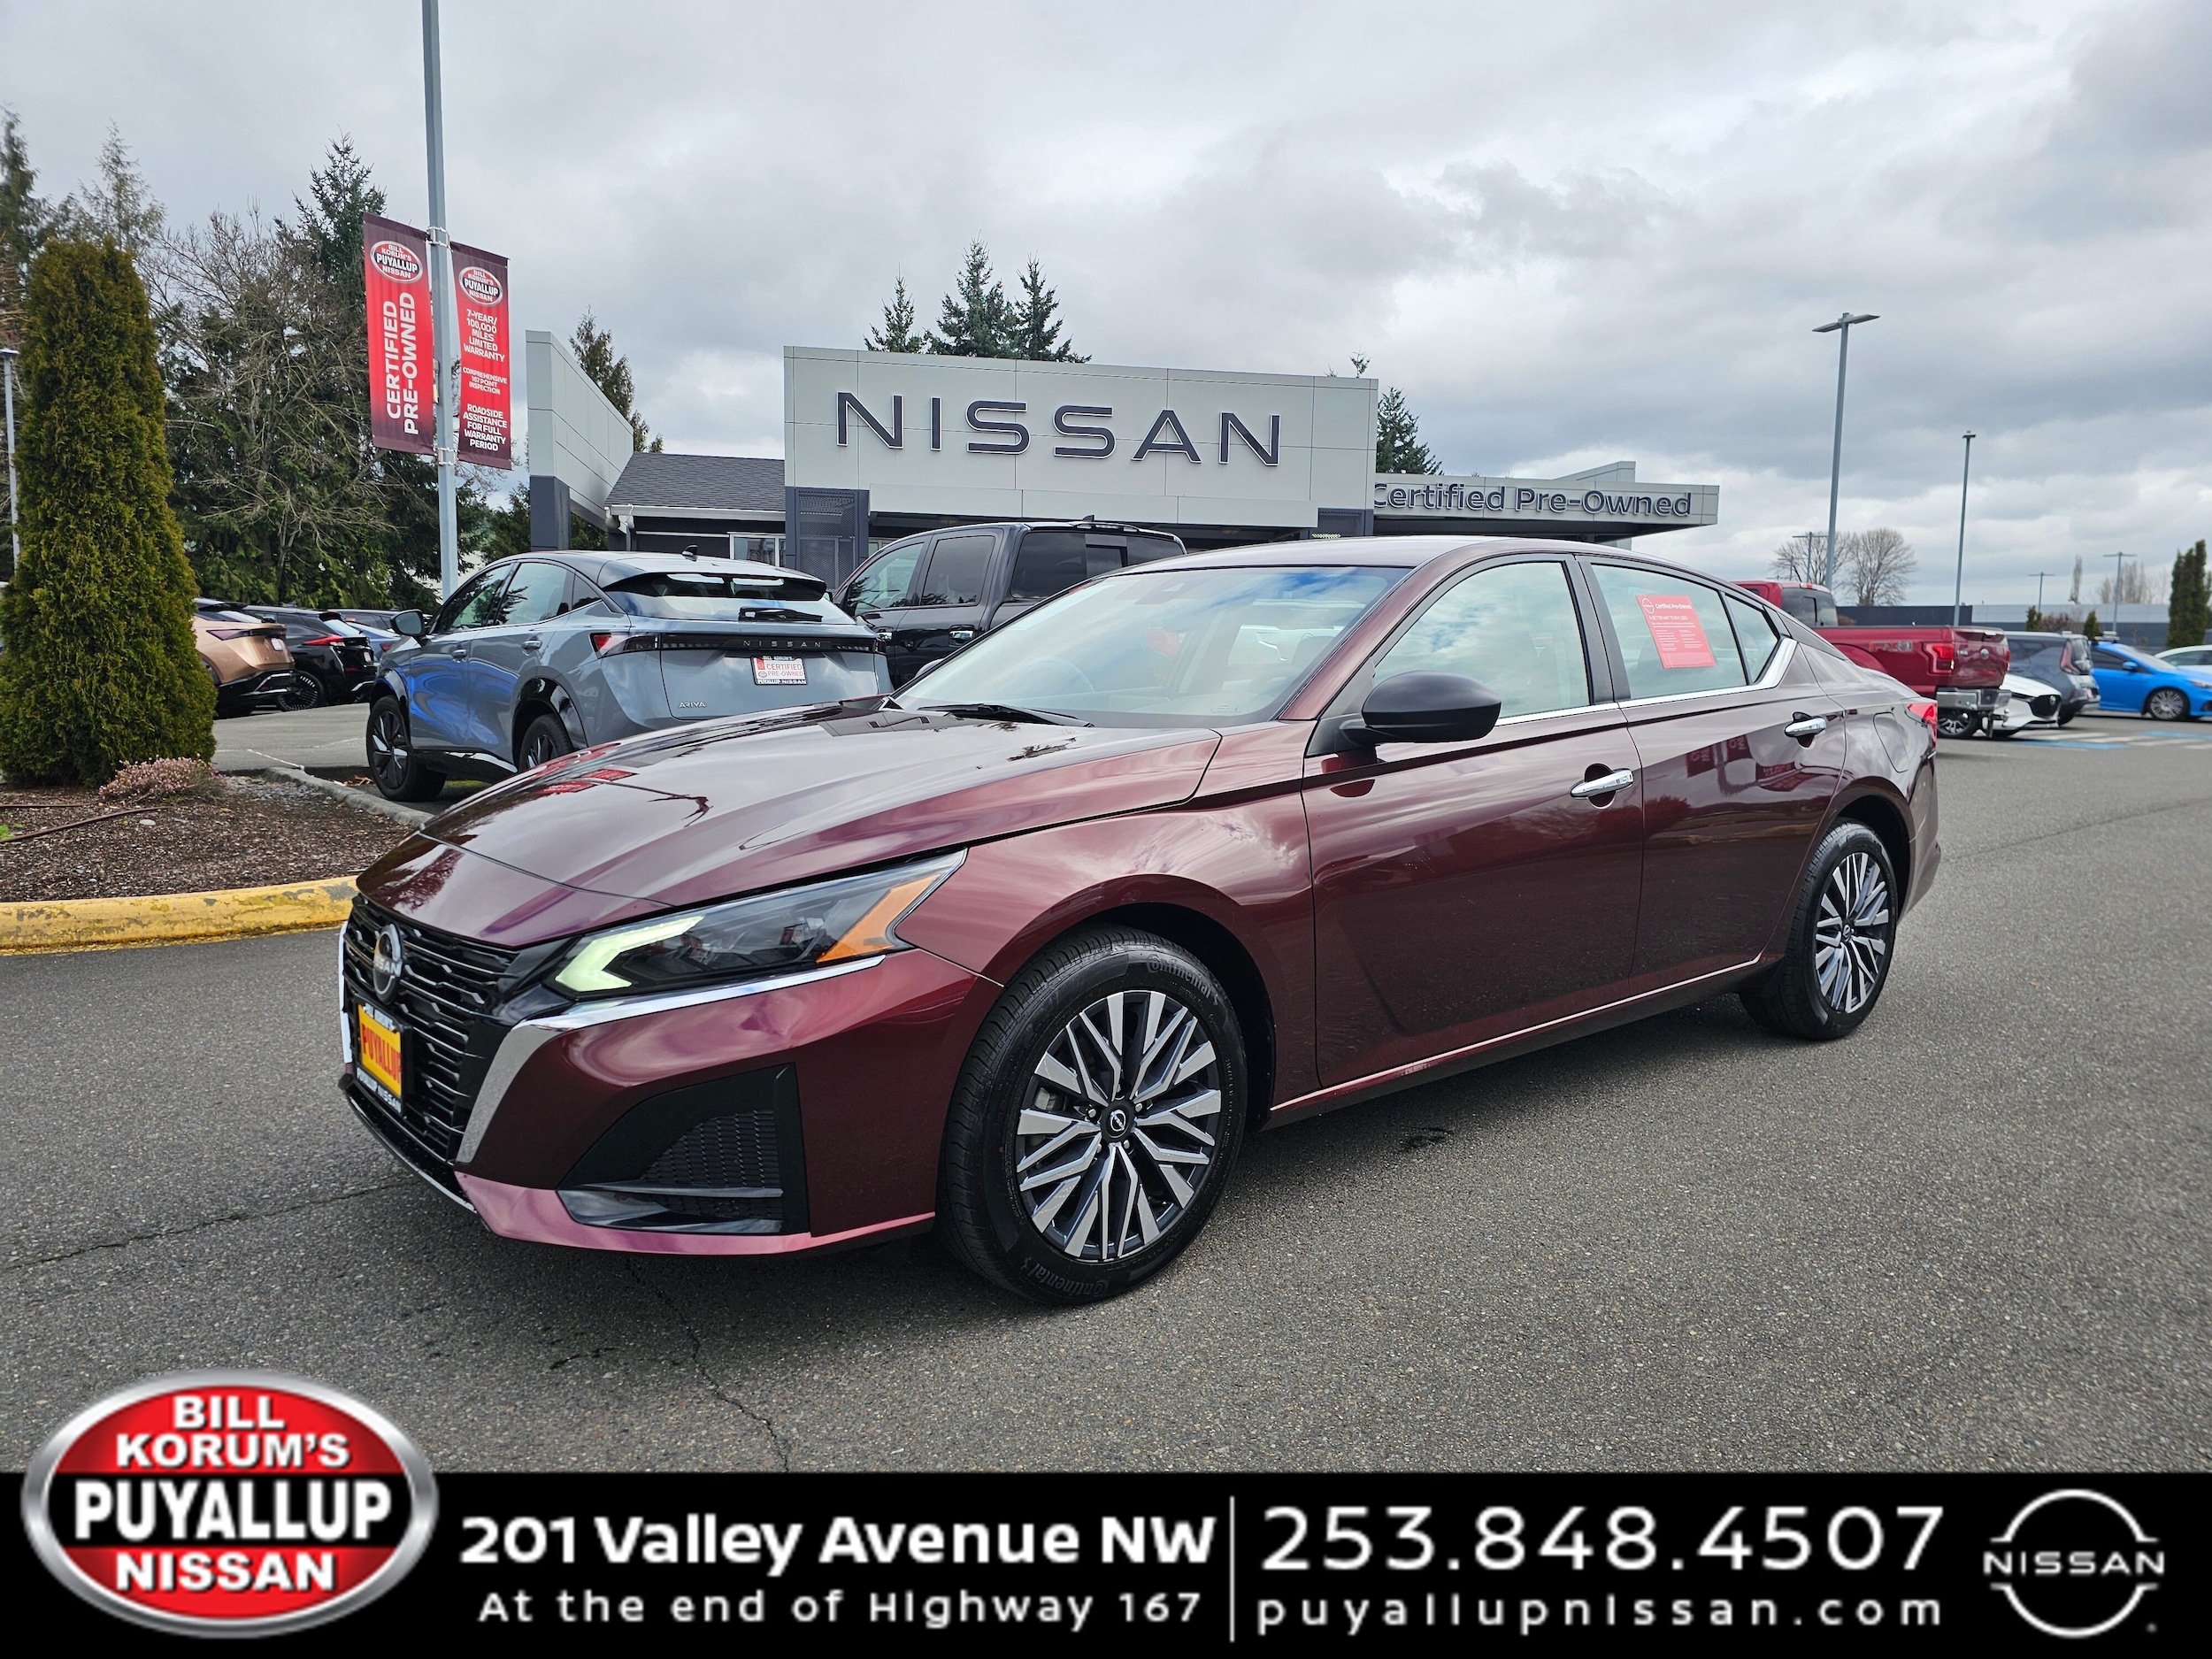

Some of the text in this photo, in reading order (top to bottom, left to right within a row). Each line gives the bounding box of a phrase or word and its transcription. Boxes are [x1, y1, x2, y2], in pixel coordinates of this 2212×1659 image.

[381, 248, 412, 261] KORUM'S
[388, 244, 403, 253] BILL
[376, 253, 418, 273] PUYALLUP
[382, 265, 411, 279] NISSAN
[473, 269, 487, 279] BILL
[464, 278, 499, 296] PUYALLUP
[469, 290, 493, 302] NISSAN
[466, 309, 497, 326] 7-YEAR/
[466, 318, 497, 334] 100,000
[472, 328, 495, 342] MILES
[469, 336, 498, 351] LIMITED
[383, 301, 401, 419] CERTIFIED
[463, 343, 505, 362] WARRANTY
[399, 292, 419, 434] PRE-OWNED
[463, 367, 508, 384] COMPREHENSIVE
[469, 381, 500, 395] INSPECTION
[467, 403, 503, 419] ROADSIDE
[463, 411, 507, 428] ASSISTANCE
[467, 421, 502, 435] FOR FULL
[837, 392, 1280, 466] NISSAN
[465, 429, 506, 444] WARRANTY
[470, 439, 498, 451] PERIOD
[1374, 483, 1692, 516] Certified Pre-Owned
[1147, 954, 1211, 999] Continental
